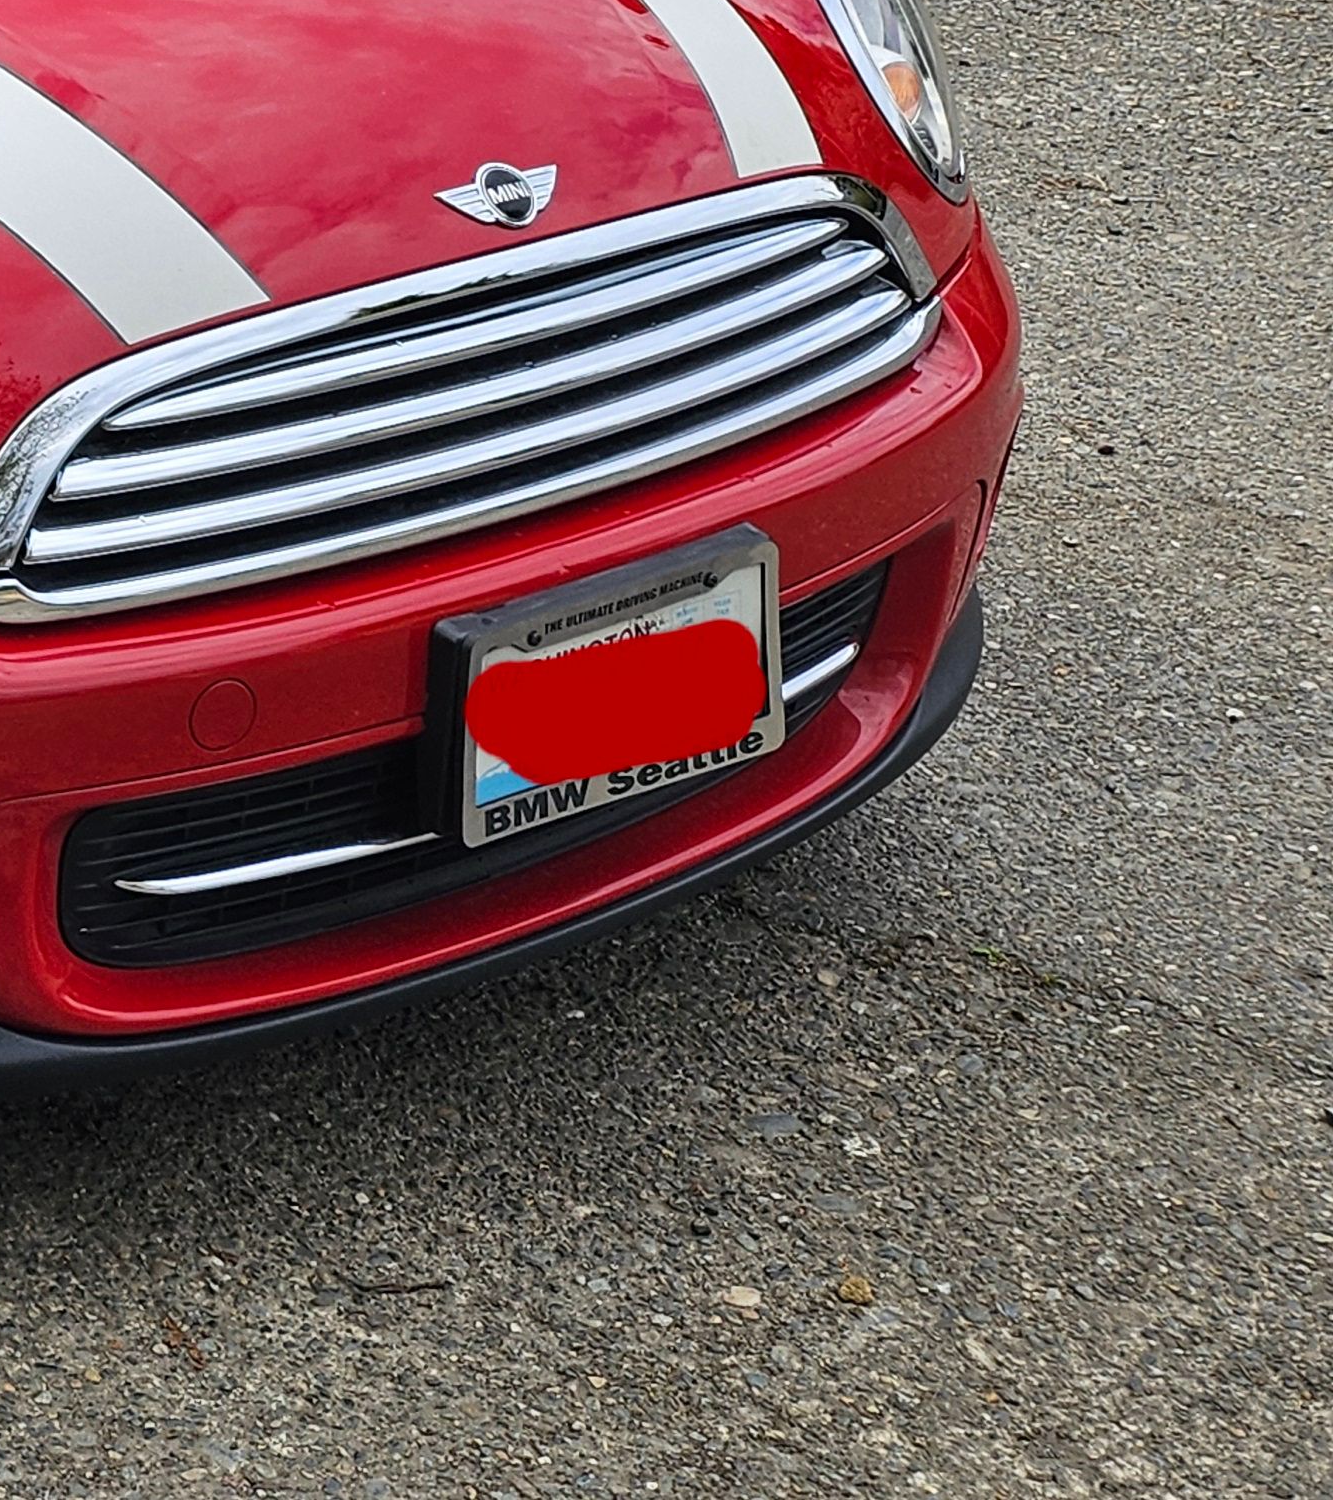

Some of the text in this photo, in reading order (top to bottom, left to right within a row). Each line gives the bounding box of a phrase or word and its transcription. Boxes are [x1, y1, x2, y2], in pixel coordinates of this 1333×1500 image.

[487, 181, 531, 204] MINI
[544, 572, 703, 635] THE ULTIMATE DRIVING MACHINE
[484, 778, 589, 837] BMW
